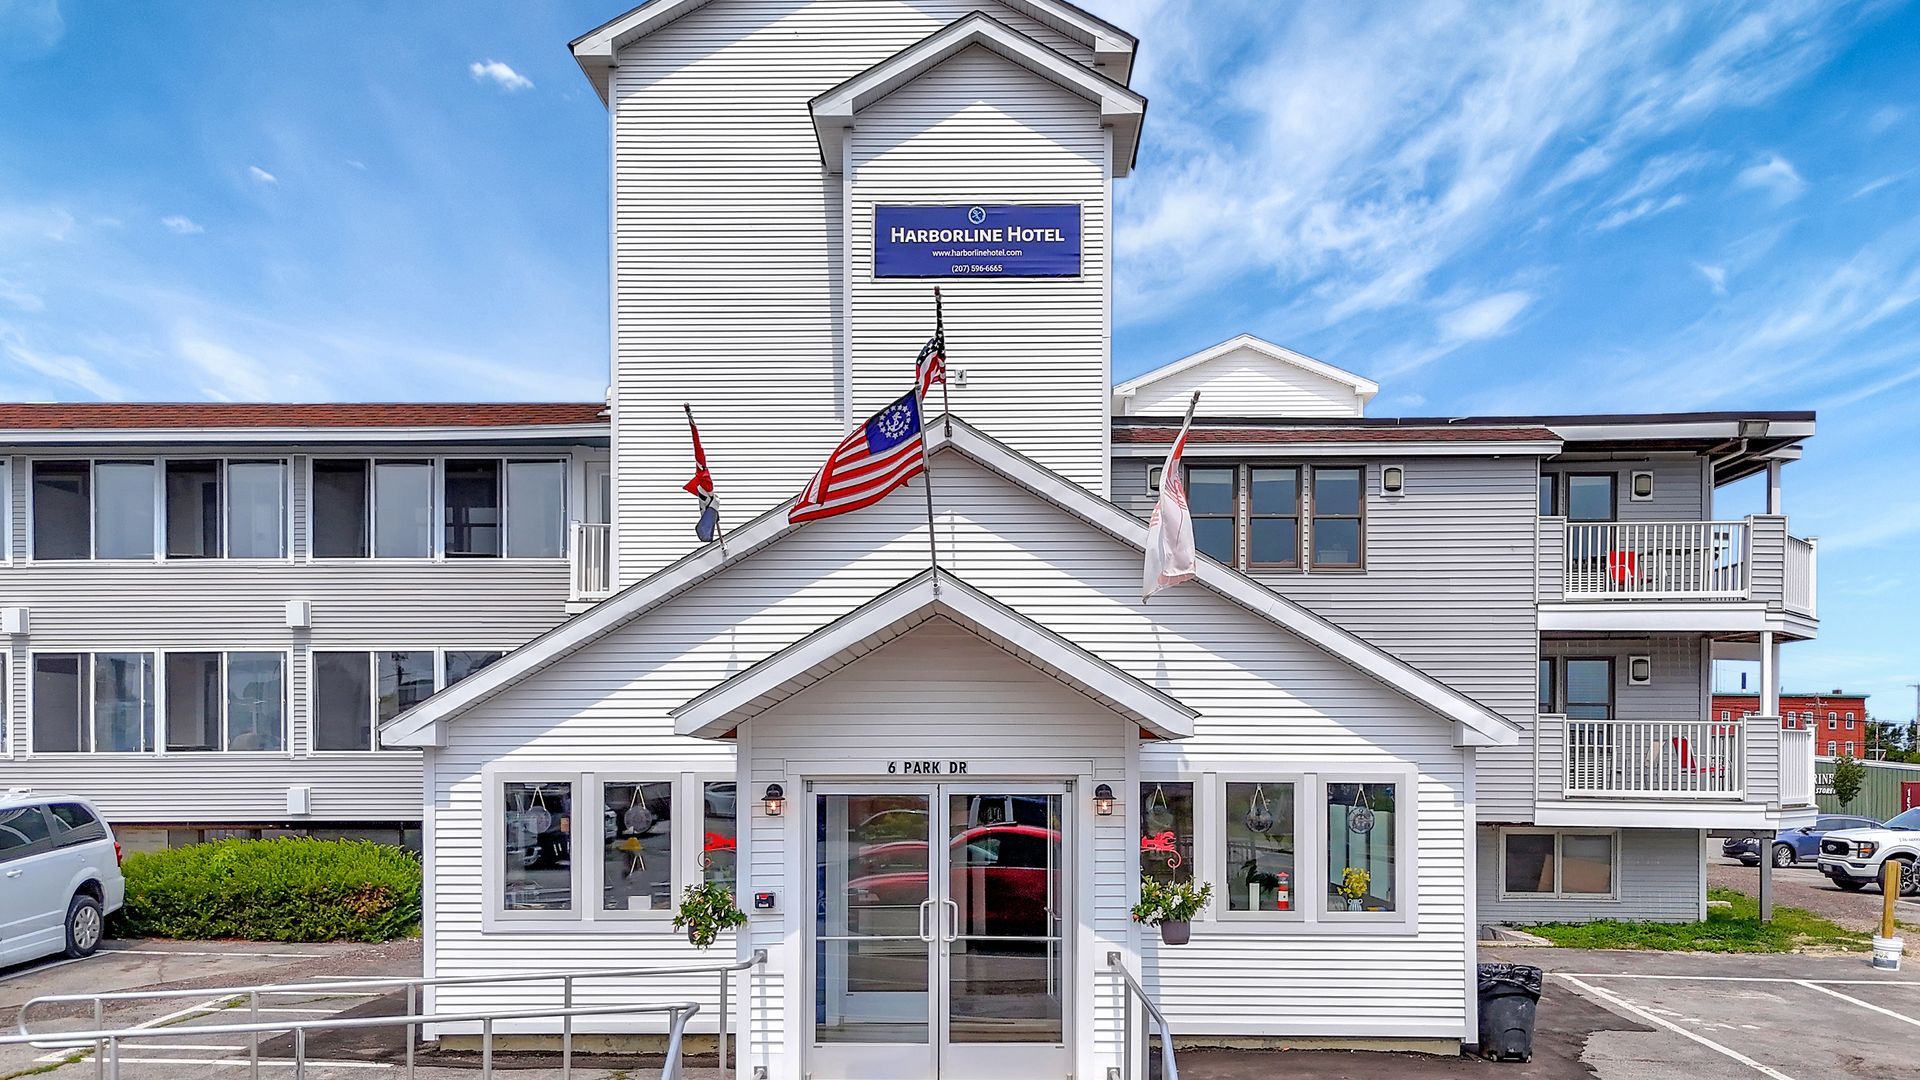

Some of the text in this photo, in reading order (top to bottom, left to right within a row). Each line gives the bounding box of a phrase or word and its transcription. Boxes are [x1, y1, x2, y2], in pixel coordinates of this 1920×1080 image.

[891, 226, 1065, 243] HARBORLINE HOTEL
[932, 249, 1022, 257] www.harborlinehotel.com
[951, 264, 1003, 273] (207) 596-6665
[888, 761, 967, 774] 6 PARK DR
